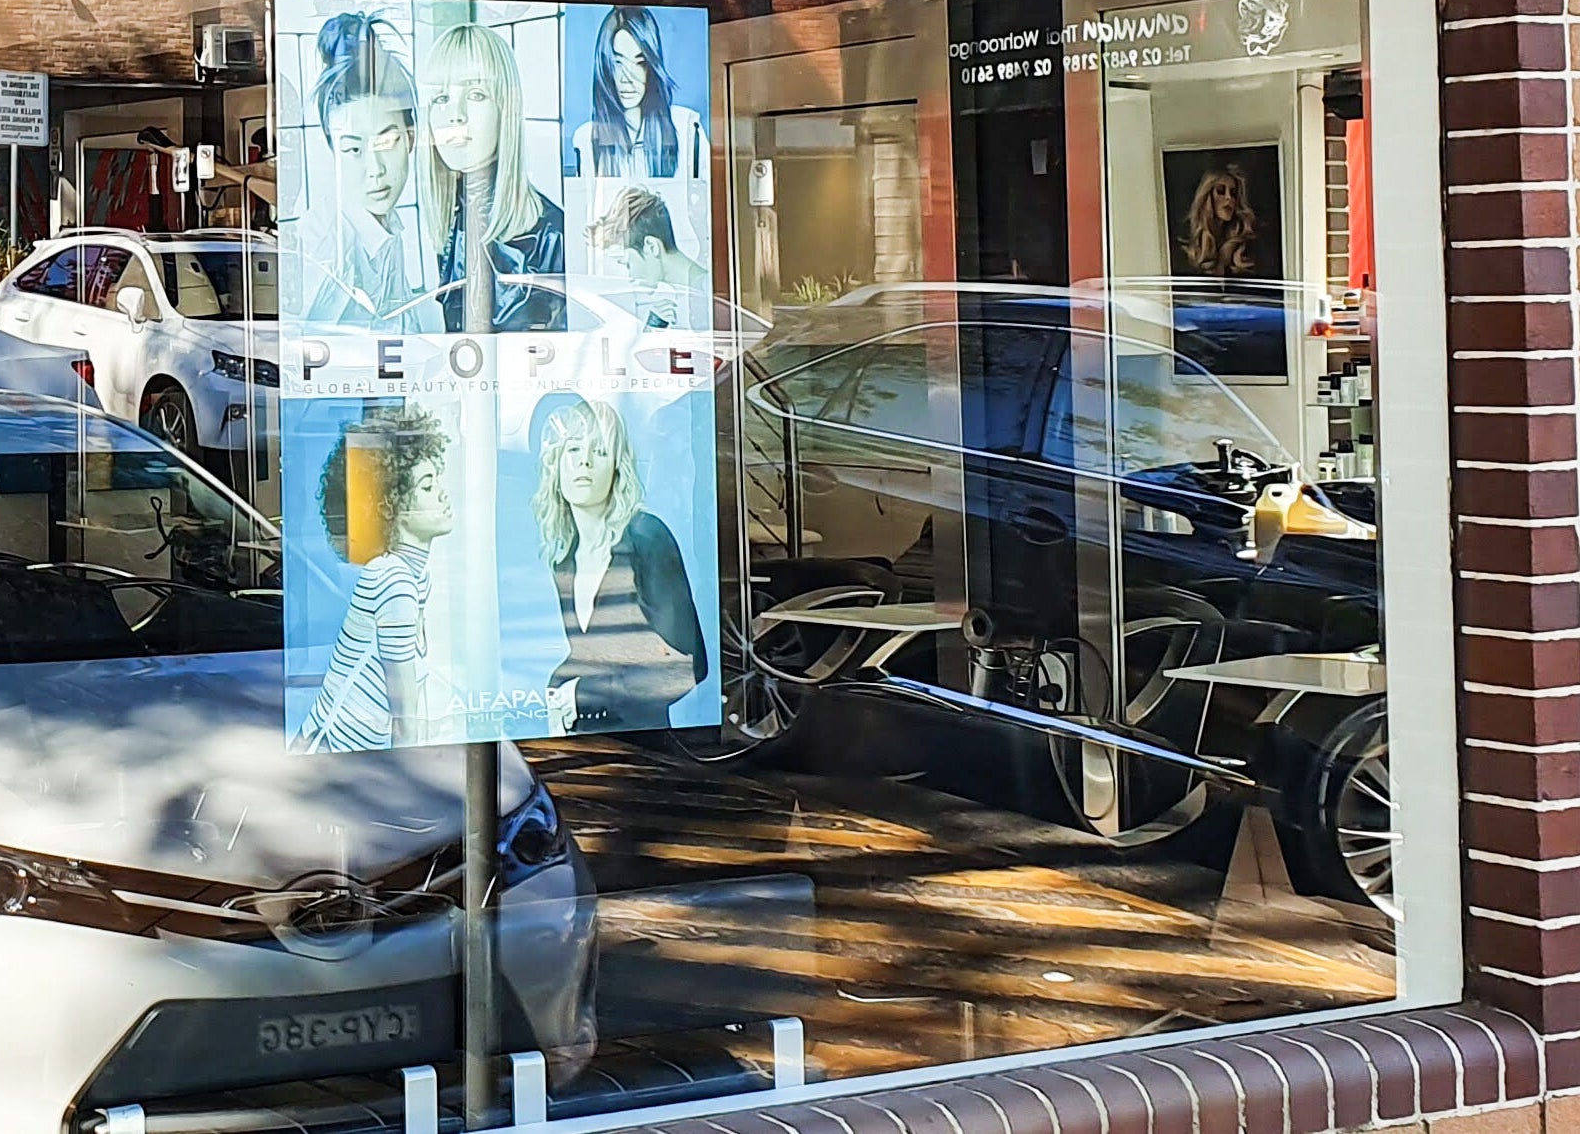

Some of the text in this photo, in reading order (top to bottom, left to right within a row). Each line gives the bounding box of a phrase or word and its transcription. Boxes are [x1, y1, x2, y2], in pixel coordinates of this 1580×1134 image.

[303, 337, 695, 380] PEOPLE
[304, 382, 374, 394] GLOBAL
[387, 381, 457, 393] BEAUTY
[468, 380, 499, 392] FOR
[631, 378, 696, 389] PEOPLE
[445, 687, 560, 712] ALFAPAR
